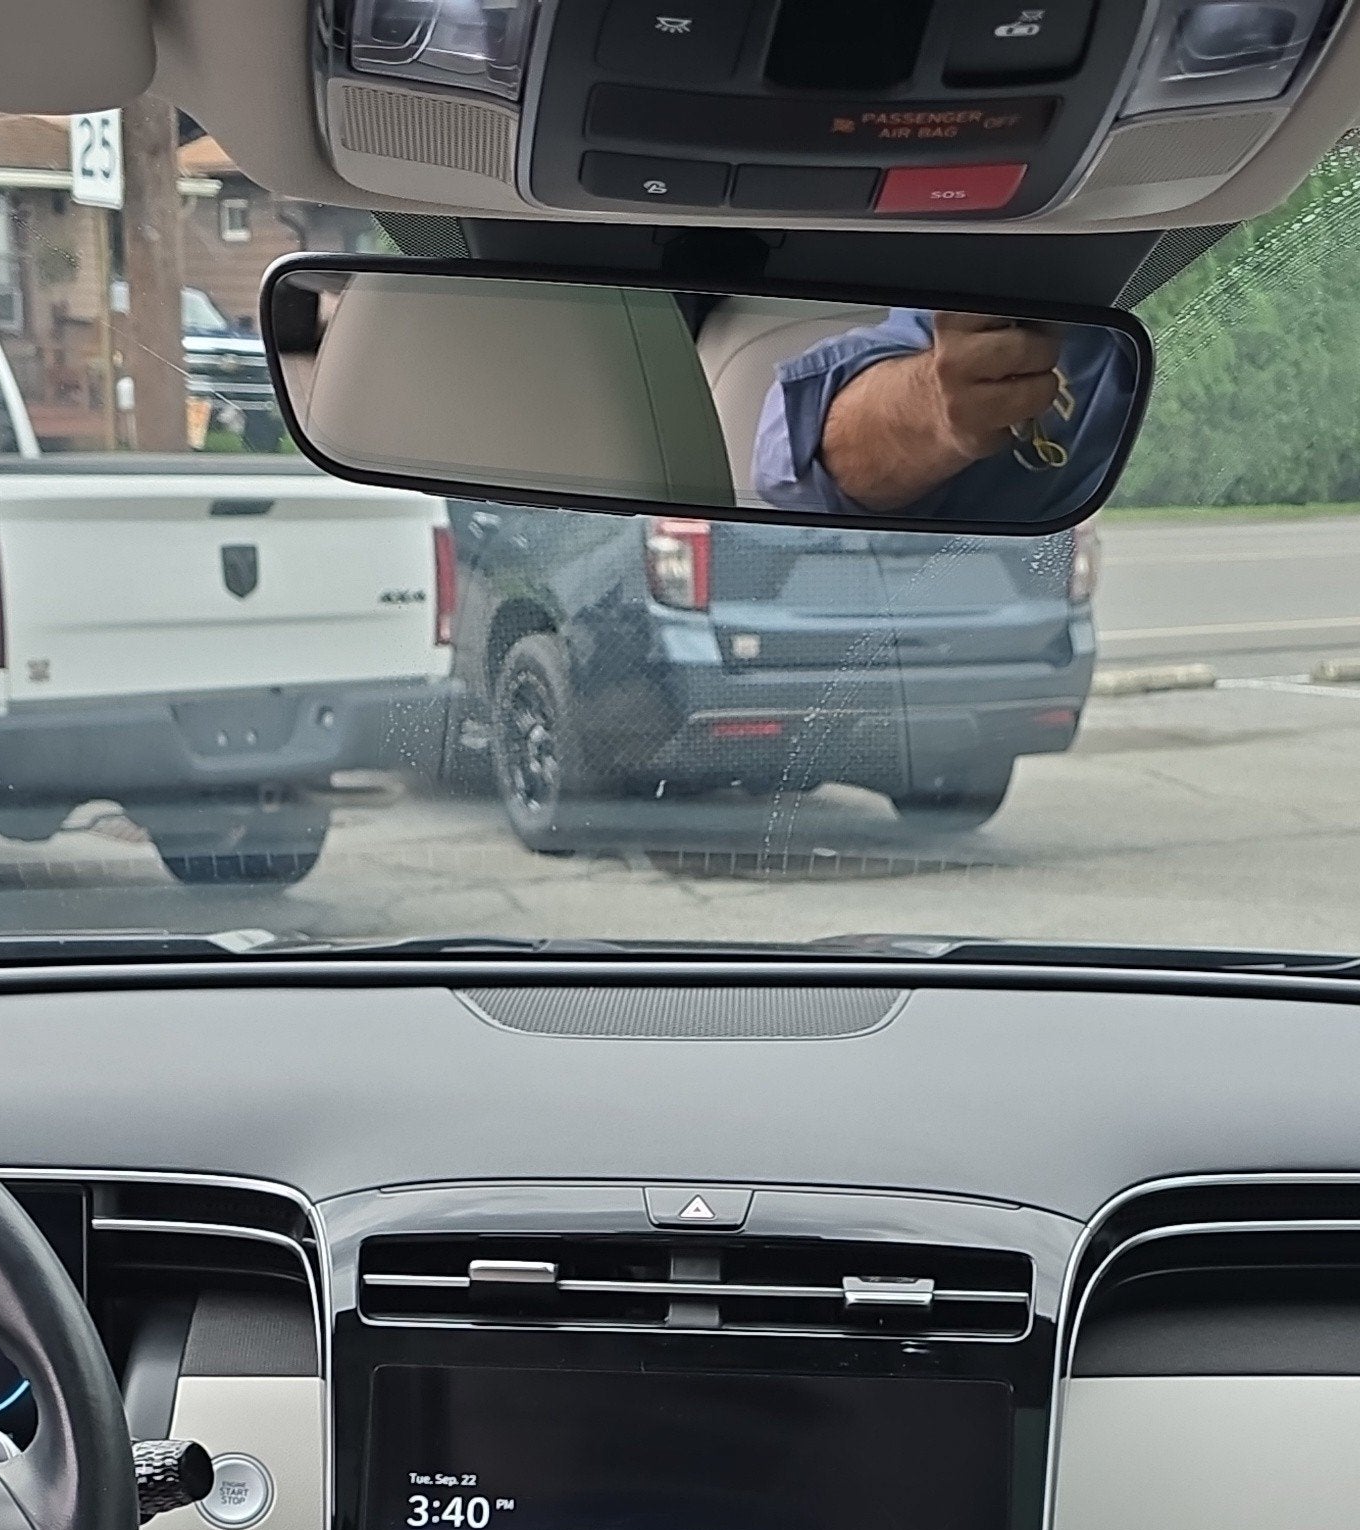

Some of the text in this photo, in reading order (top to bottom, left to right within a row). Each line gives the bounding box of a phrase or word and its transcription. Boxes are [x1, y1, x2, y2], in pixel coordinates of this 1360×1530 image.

[861, 110, 984, 124] PASSENGER
[877, 126, 959, 139] AIR BAG
[79, 116, 116, 179] 25
[930, 190, 967, 200] SOS
[408, 1472, 478, 1487] Tue. Sep. 22
[219, 1488, 249, 1497] START
[220, 1495, 246, 1505] STOP
[406, 1494, 515, 1529] 3:40 PM
